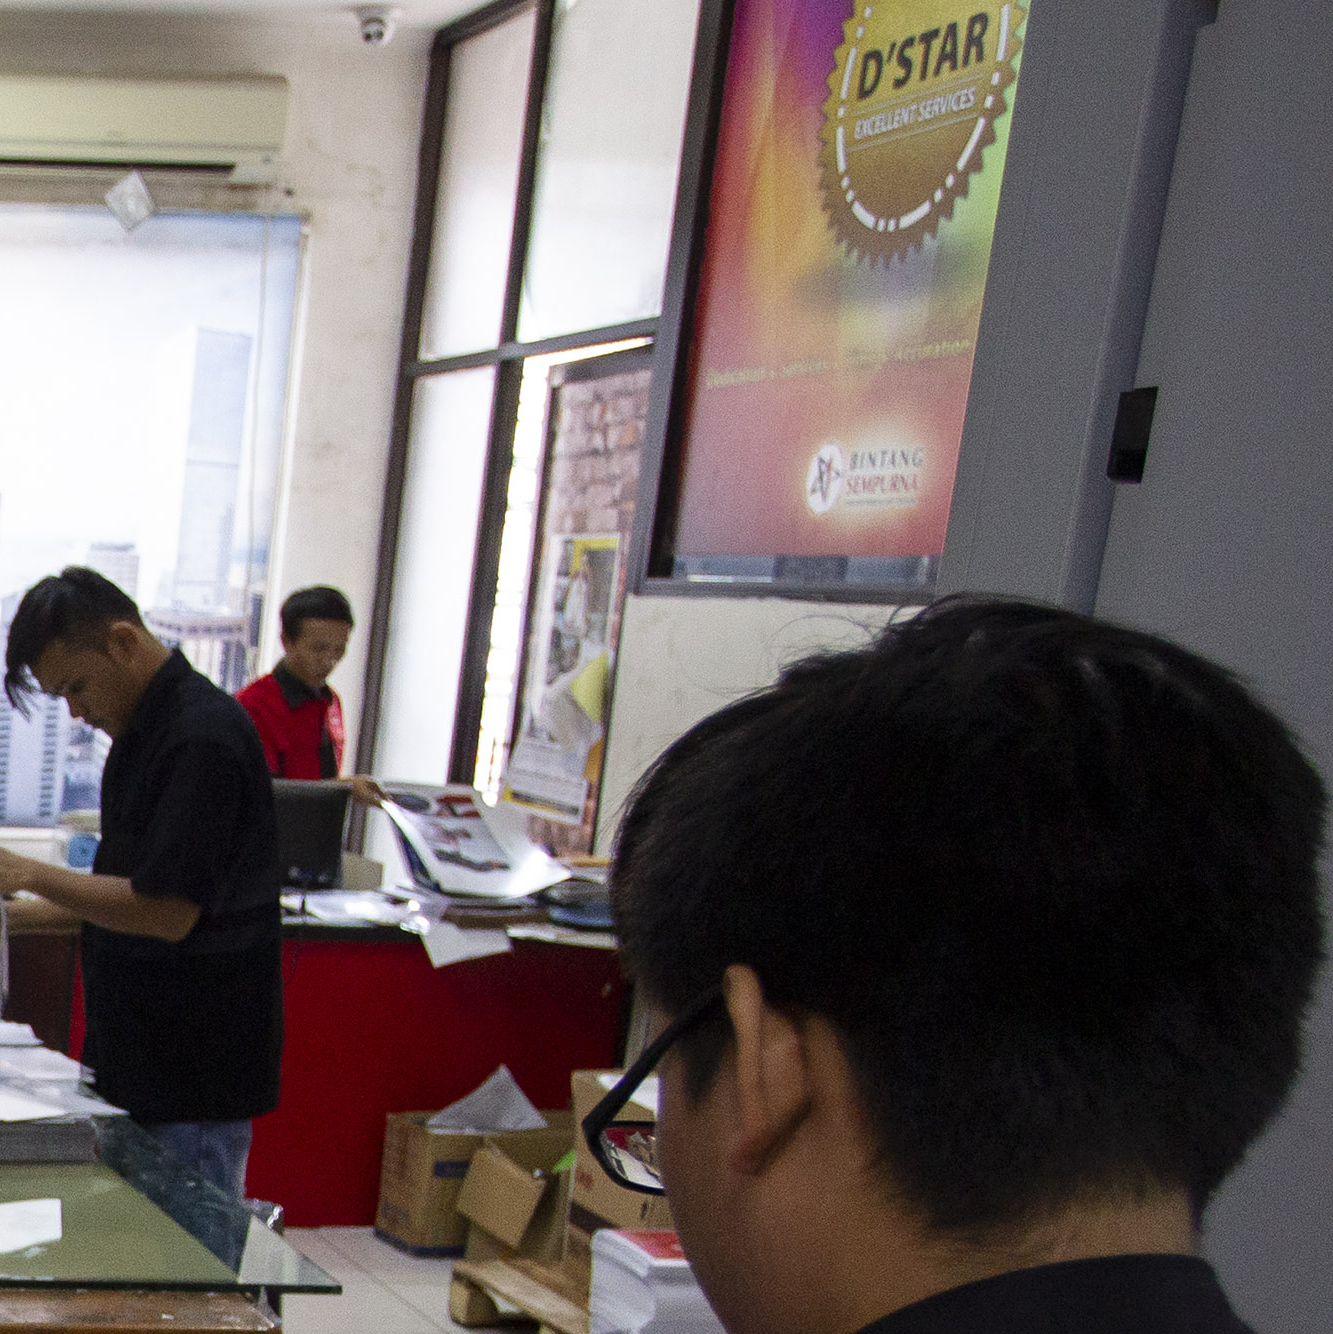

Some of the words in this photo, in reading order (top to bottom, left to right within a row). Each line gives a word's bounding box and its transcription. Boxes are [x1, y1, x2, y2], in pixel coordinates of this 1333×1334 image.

[856, 11, 990, 101] D'STAR
[853, 104, 917, 140] EXCELLENT
[917, 86, 977, 121] SERVICES
